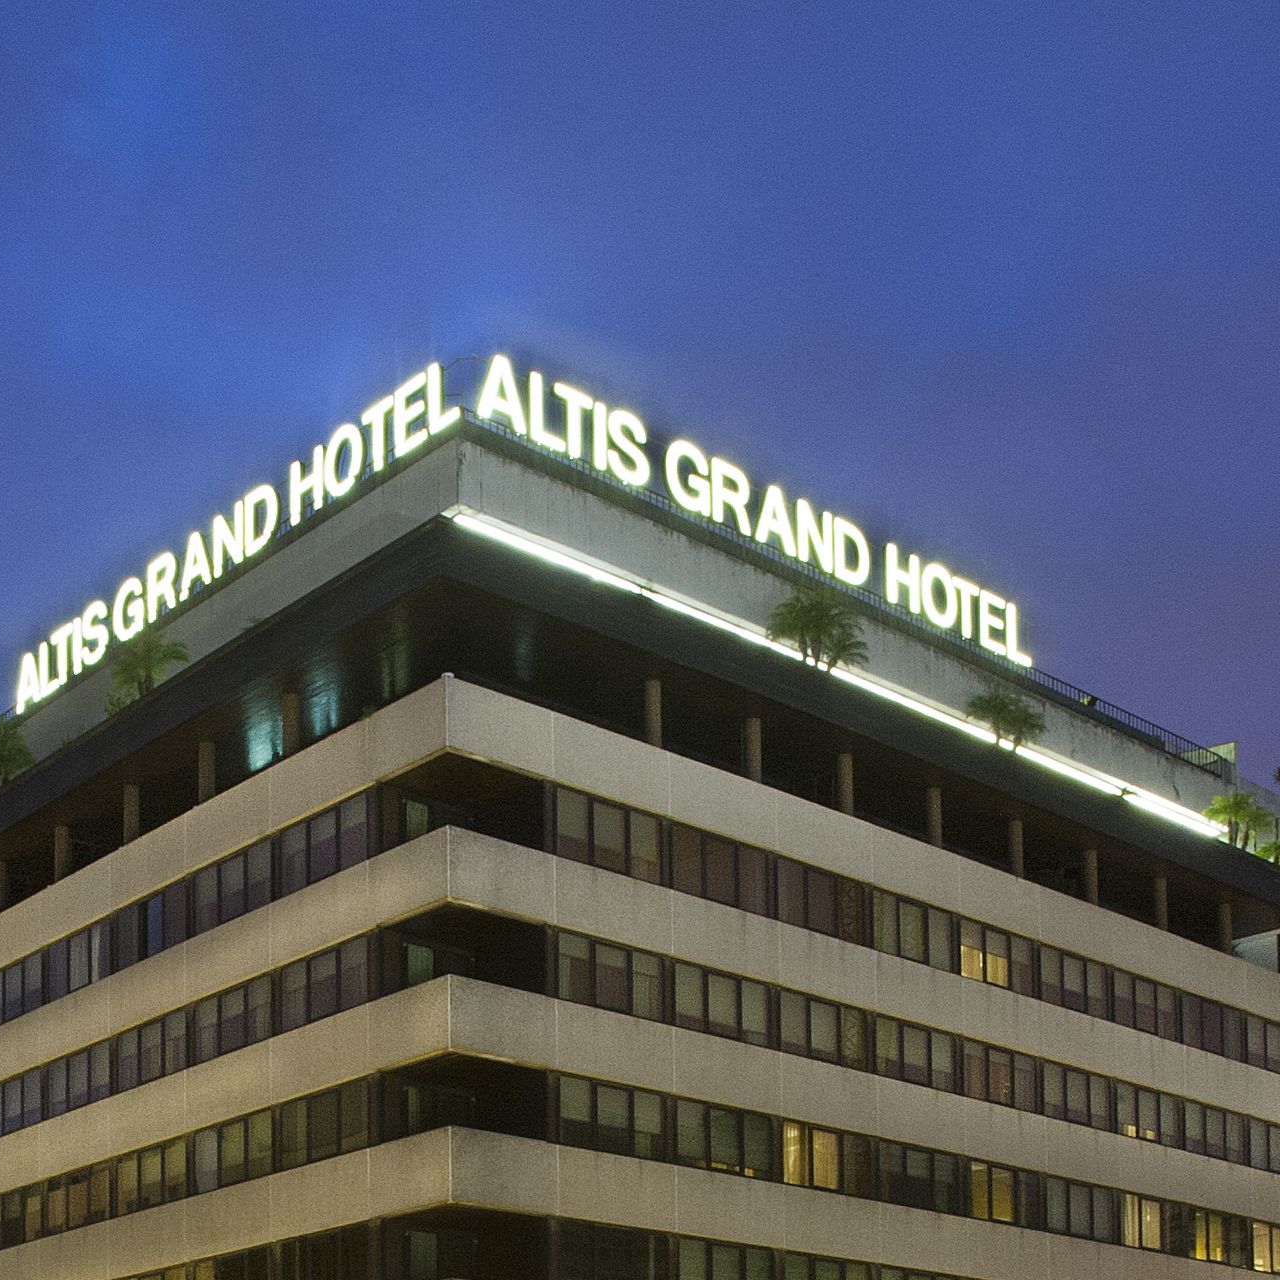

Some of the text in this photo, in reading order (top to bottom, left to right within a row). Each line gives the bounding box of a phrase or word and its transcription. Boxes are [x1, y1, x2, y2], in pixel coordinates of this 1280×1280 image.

[14, 360, 462, 716] ALTIS GRAND HOTEL
[474, 352, 1034, 669] ALTIS GRAND HOTEL
